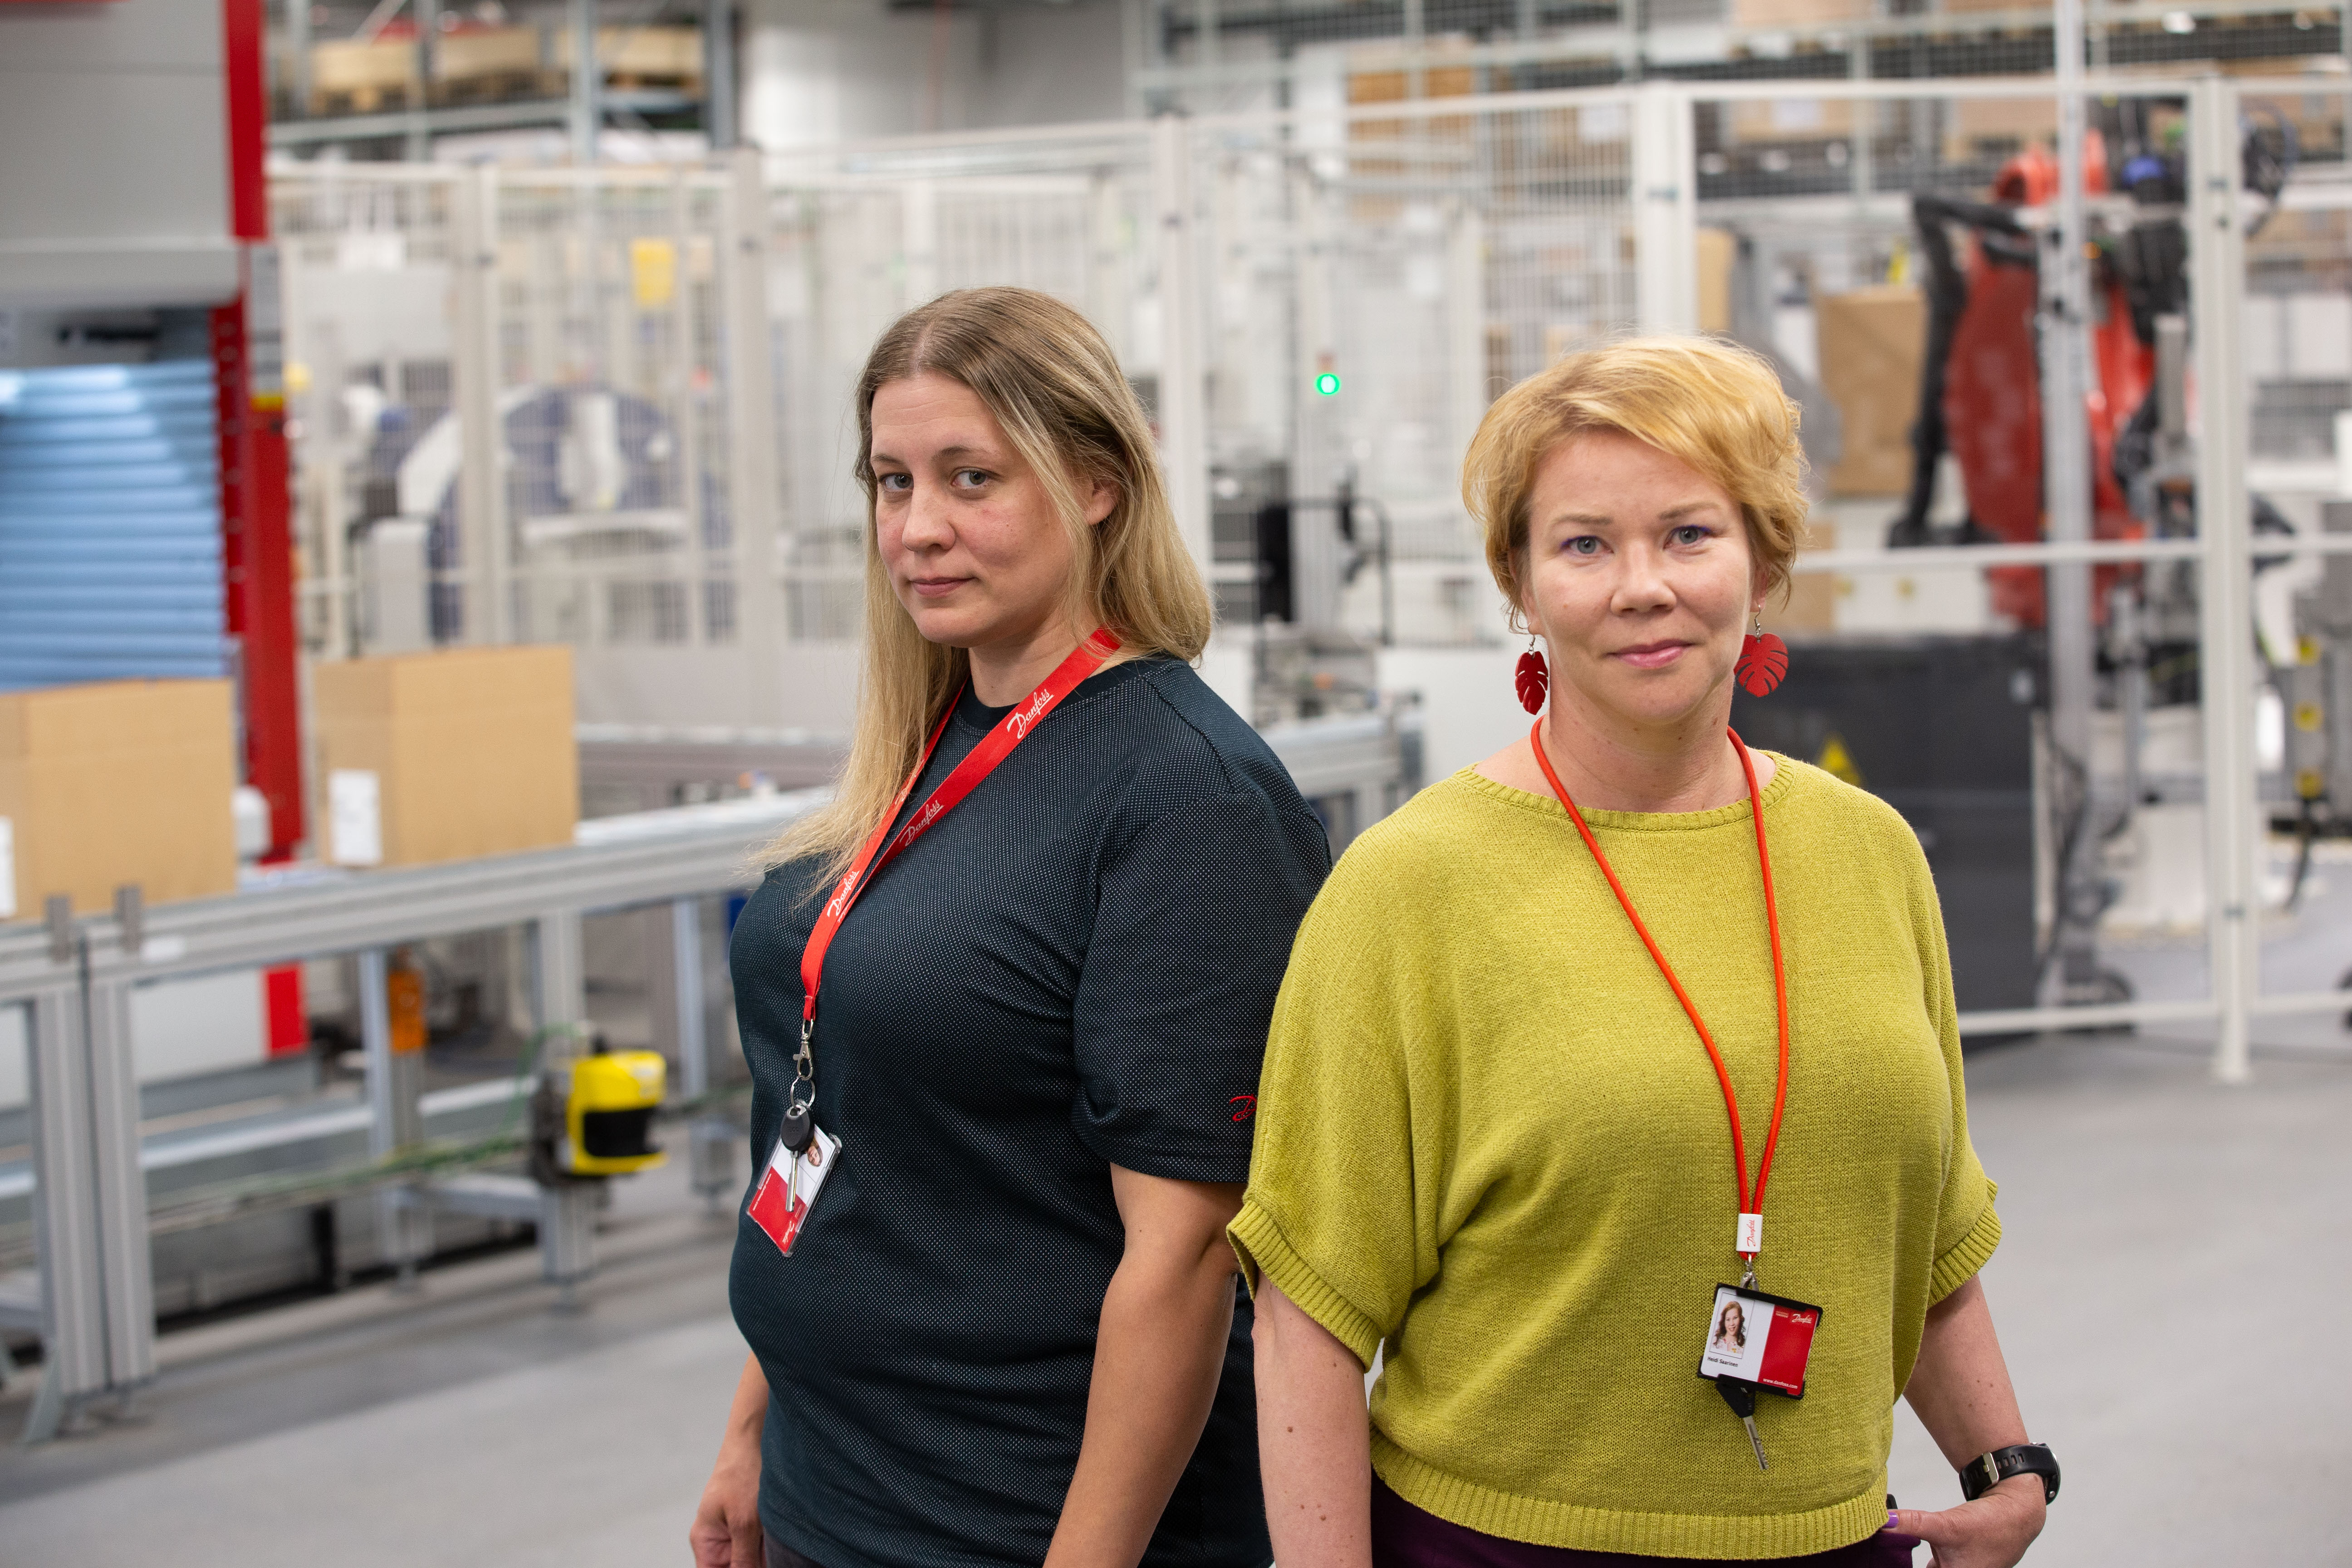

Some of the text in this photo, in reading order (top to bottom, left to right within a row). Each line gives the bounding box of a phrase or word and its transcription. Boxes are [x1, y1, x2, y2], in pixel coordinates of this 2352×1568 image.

[1006, 688, 1054, 740] Danfoss
[899, 799, 944, 846] Danfoss
[827, 870, 861, 917] Danfoss
[1746, 1219, 1756, 1248] Danfoss
[1792, 1313, 1813, 1324] Danfoss
[1763, 1378, 1798, 1389] www.danfoss.com
